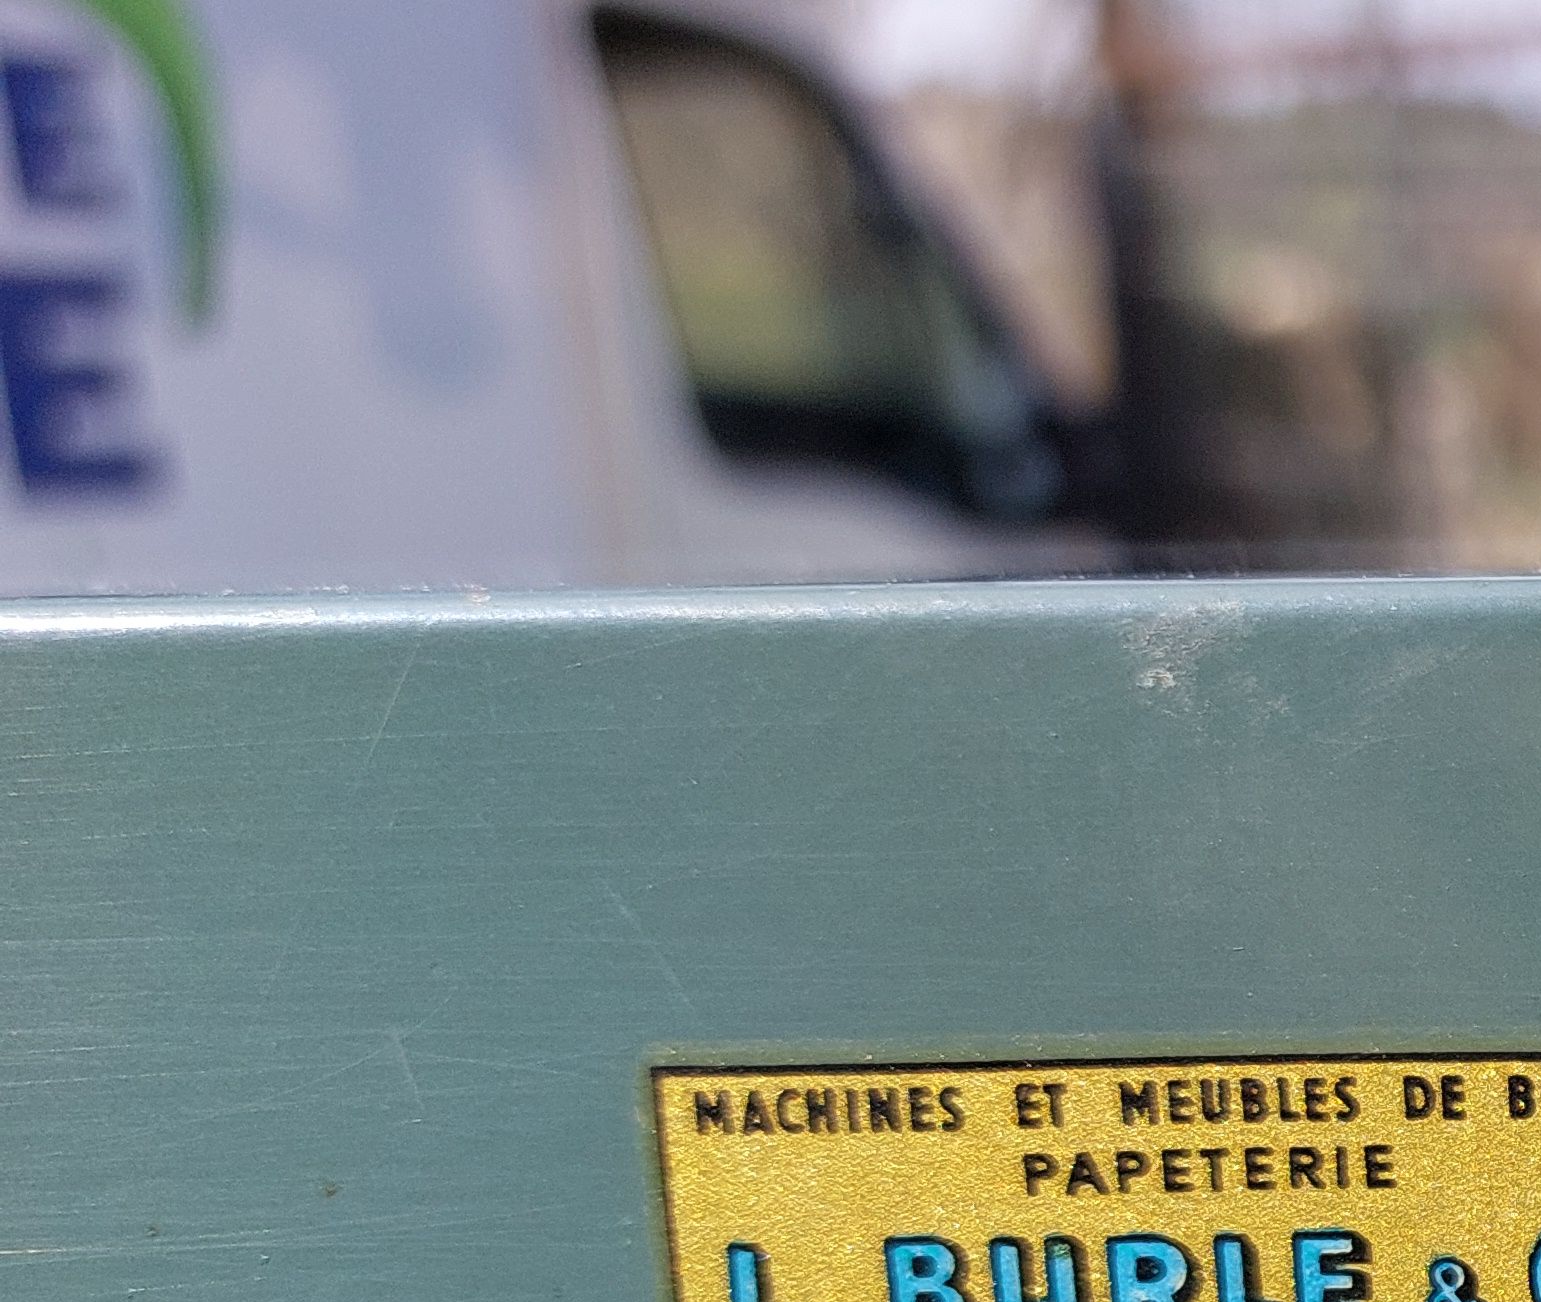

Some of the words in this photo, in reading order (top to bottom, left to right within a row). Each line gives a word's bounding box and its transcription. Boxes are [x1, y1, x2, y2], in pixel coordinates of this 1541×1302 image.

[695, 1086, 967, 1136] MACHINES
[1015, 1082, 1068, 1130] ET
[1118, 1075, 1361, 1126] MEUBLES
[1403, 1073, 1467, 1121] DE
[1023, 1145, 1398, 1196] PAPETERIE
